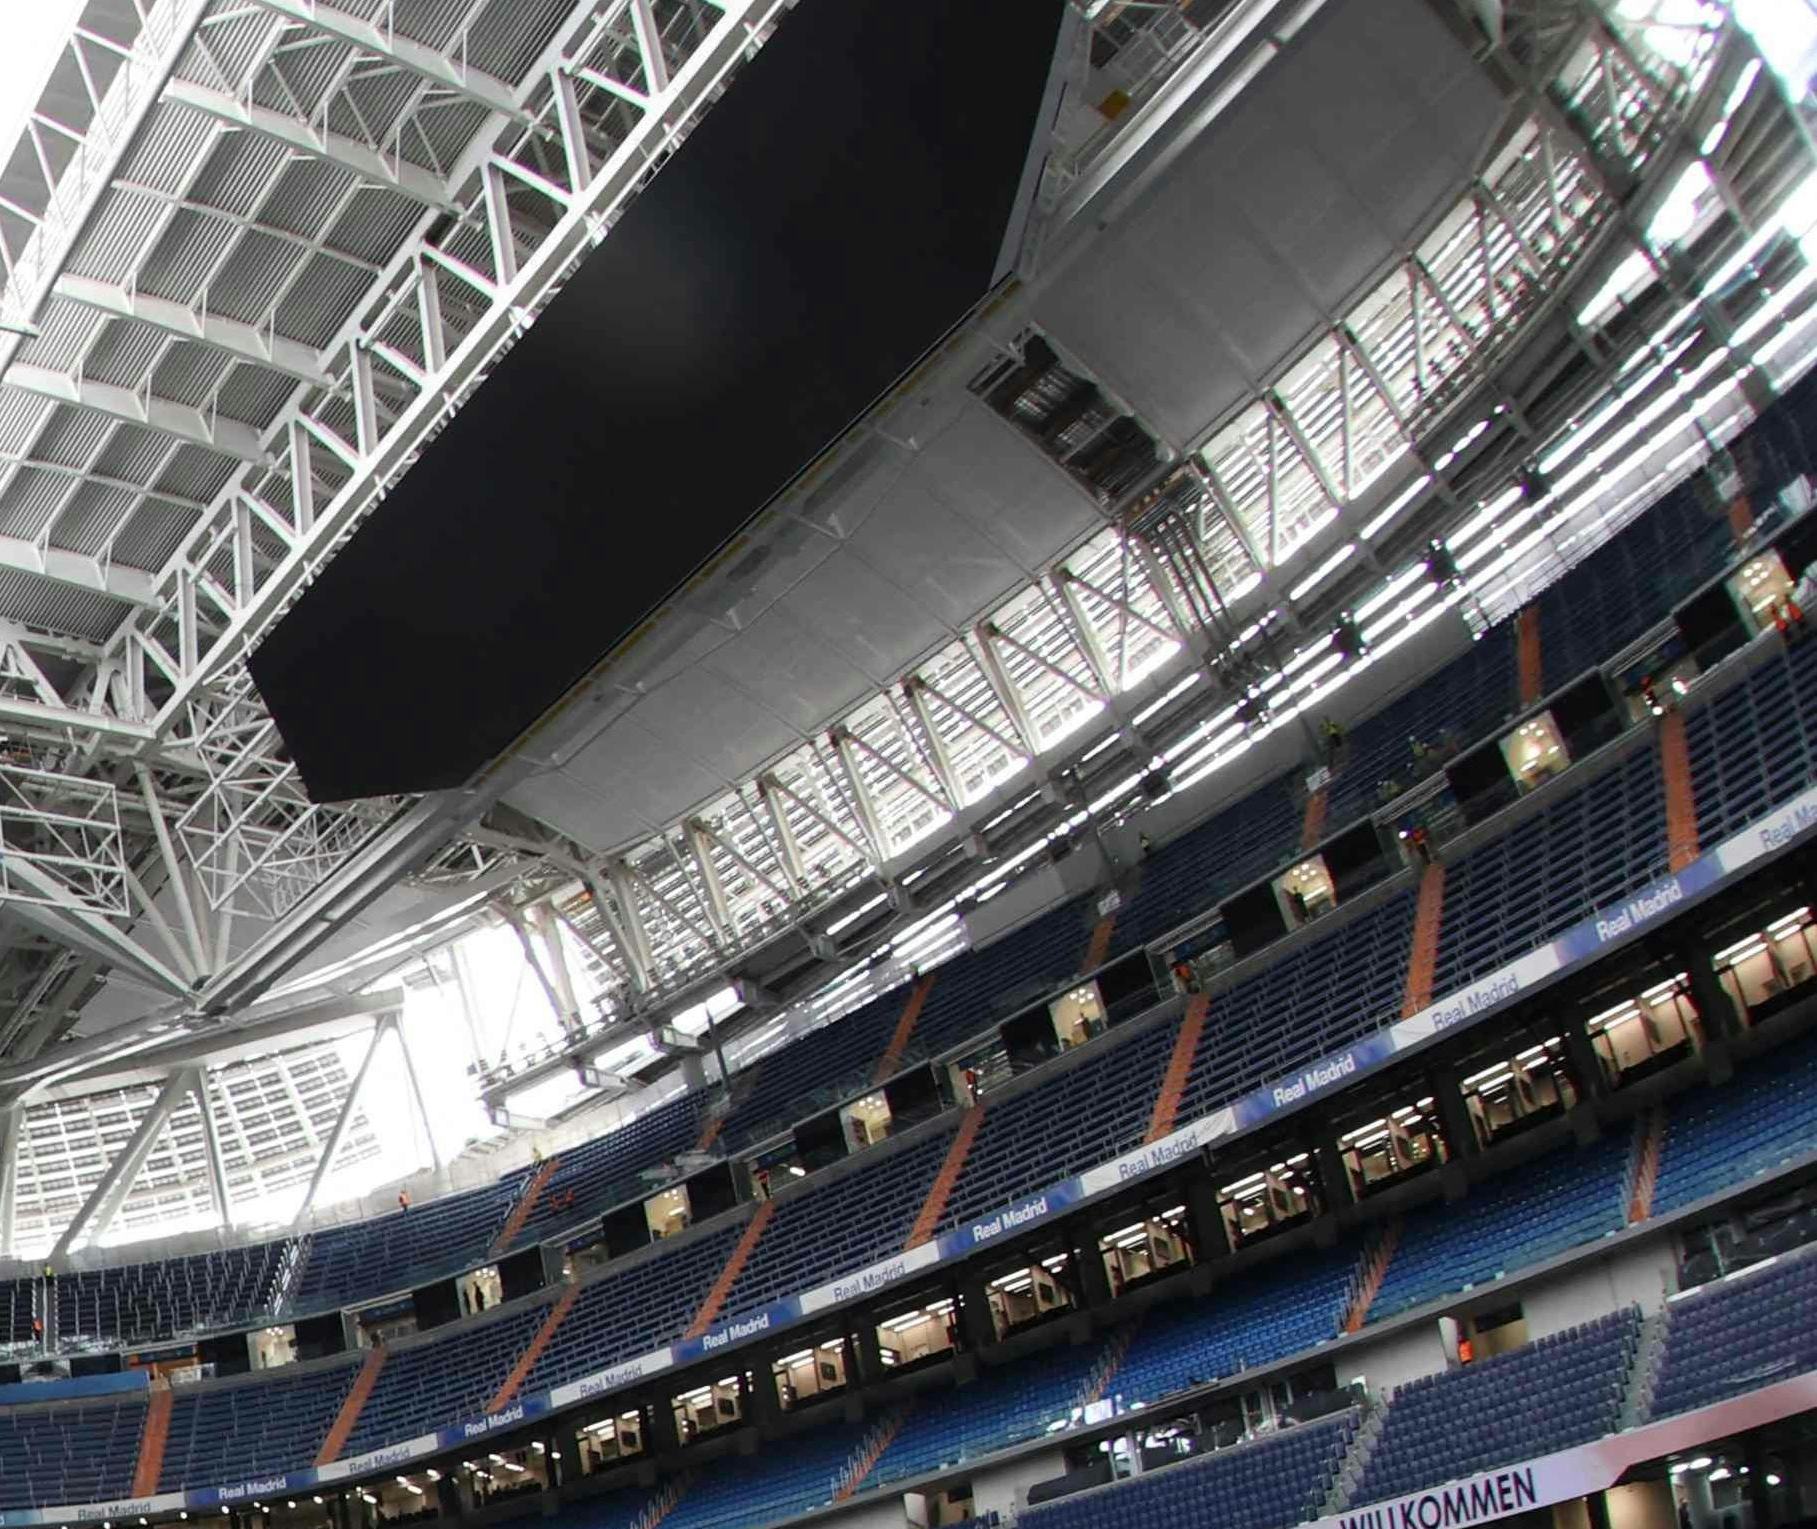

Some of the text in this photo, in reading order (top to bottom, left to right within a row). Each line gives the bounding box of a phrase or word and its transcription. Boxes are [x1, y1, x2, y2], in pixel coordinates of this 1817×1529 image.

[1758, 814, 1796, 850] Real
[1596, 878, 1683, 942] Real Madrid
[1431, 973, 1520, 1032] Real Madrid
[1273, 1053, 1355, 1108] Real Madrid
[1118, 1133, 1199, 1181] Real Madrid
[973, 1198, 1048, 1241] Real Madrid
[833, 1260, 906, 1301] Real Madrid
[702, 1314, 770, 1351] Real Madrid
[580, 1365, 643, 1398] Real Madrid
[464, 1406, 524, 1438] Real Madrid
[349, 1446, 411, 1475] Real Madrid
[218, 1476, 286, 1499] Real Madrid
[77, 1501, 152, 1521] Real Madrid
